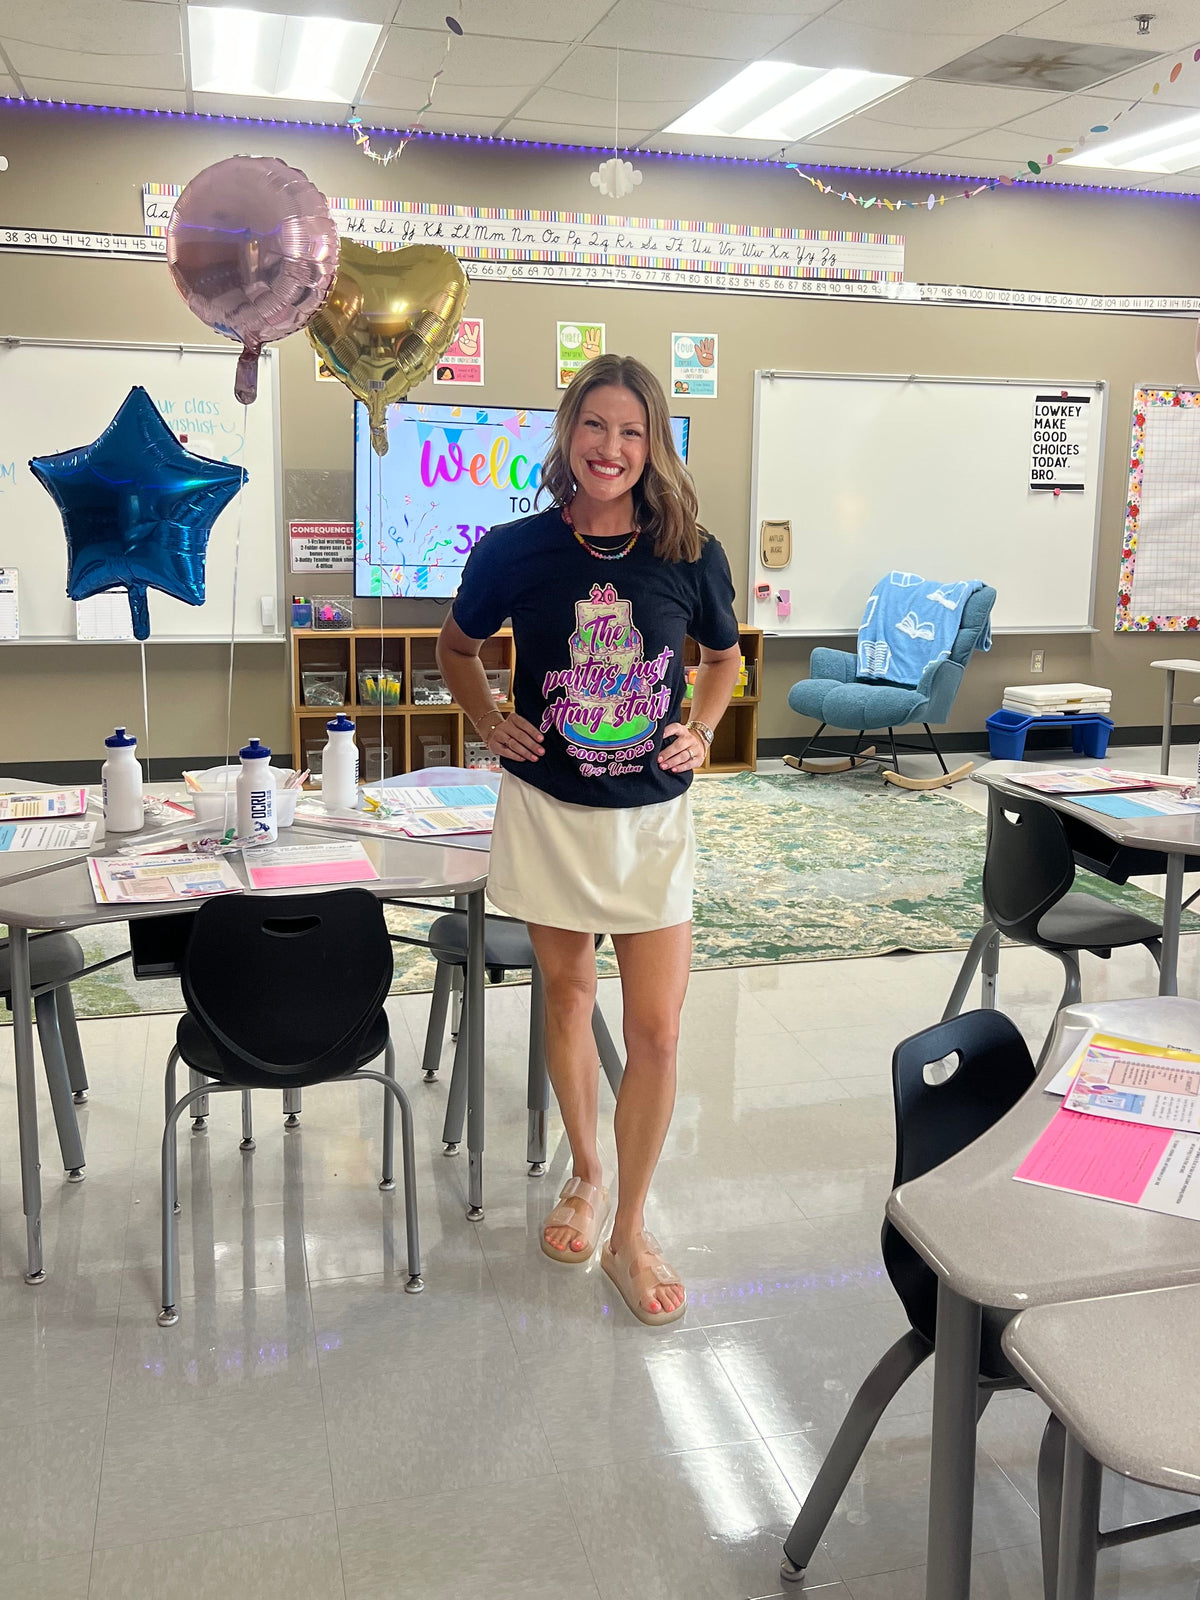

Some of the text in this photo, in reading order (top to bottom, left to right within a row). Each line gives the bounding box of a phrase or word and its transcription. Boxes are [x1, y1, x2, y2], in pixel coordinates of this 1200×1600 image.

[147, 204, 170, 218] Aa
[347, 217, 366, 232] Hh
[374, 219, 394, 234] Ii
[402, 221, 416, 241] Jj
[424, 222, 444, 237] Kk
[451, 224, 470, 239] Ll
[475, 225, 505, 240] Mm
[512, 227, 535, 243] Nn
[542, 228, 560, 243] Oo
[567, 230, 581, 250] Pp
[615, 234, 633, 248] Rr
[641, 234, 657, 249] Ss
[666, 238, 683, 251] Tt
[692, 240, 711, 254] Uu
[719, 241, 735, 255] Vv
[742, 243, 764, 257] Ww
[771, 245, 789, 259] Xx
[796, 246, 814, 265] Yy
[822, 248, 837, 266] Zz
[5, 232, 18, 242] 38
[25, 233, 37, 243] 39
[42, 235, 57, 244] 40
[63, 236, 73, 245] 41
[78, 237, 90, 246] 42
[96, 238, 109, 247] 43
[113, 238, 127, 248] 44
[133, 240, 146, 249] 45
[151, 241, 164, 250] 46
[467, 265, 477, 273] 65
[482, 266, 494, 274] 66
[497, 266, 507, 275] 67
[512, 267, 523, 275] 68
[528, 267, 538, 276] 69
[543, 267, 554, 276] 70
[558, 268, 566, 277] 71
[571, 268, 581, 277] 72
[586, 268, 596, 277] 73
[601, 269, 612, 277] 74
[616, 270, 626, 278] 75
[631, 270, 641, 280] 76
[646, 271, 656, 280] 77
[661, 272, 670, 281] 78
[675, 273, 685, 282] 79
[689, 274, 700, 283] 80
[704, 275, 712, 284] 81
[716, 275, 726, 285] 82
[729, 276, 739, 285] 83
[743, 277, 755, 286] 84
[759, 279, 770, 288] 85
[774, 280, 784, 288] 86
[788, 280, 798, 289] 87
[802, 282, 812, 291] 88
[816, 283, 826, 291] 89
[830, 284, 840, 292] 90
[845, 284, 853, 292] 91
[857, 285, 867, 293] 92
[927, 288, 938, 296] 97
[942, 288, 952, 296] 98
[956, 289, 966, 297] 99
[970, 290, 982, 298] 100
[986, 291, 995, 299] 101
[999, 293, 1010, 301] 102
[1013, 294, 1024, 302] 103
[1028, 294, 1041, 302] 104
[1045, 296, 1057, 304] 105
[1061, 297, 1072, 305] 106
[1076, 298, 1088, 306] 107
[1091, 298, 1102, 306] 108
[1105, 299, 1116, 307] 109
[1120, 300, 1130, 308] 110
[1158, 300, 1167, 308] 113
[1170, 300, 1178, 308] 114
[1182, 300, 1191, 308] 115
[185, 398, 220, 415] class
[1035, 405, 1081, 417] LOWKEY
[1034, 418, 1066, 429] MAKE
[1034, 431, 1067, 442] GOOD
[1033, 444, 1079, 455] CHOICES
[421, 436, 543, 492] Welco
[1032, 456, 1070, 468] TODAY.
[1031, 469, 1056, 480] BRO.
[510, 497, 530, 513] TO
[591, 588, 616, 605] 20
[584, 614, 626, 654] The
[542, 646, 674, 699] party's just
[566, 740, 655, 762] 2006-2026
